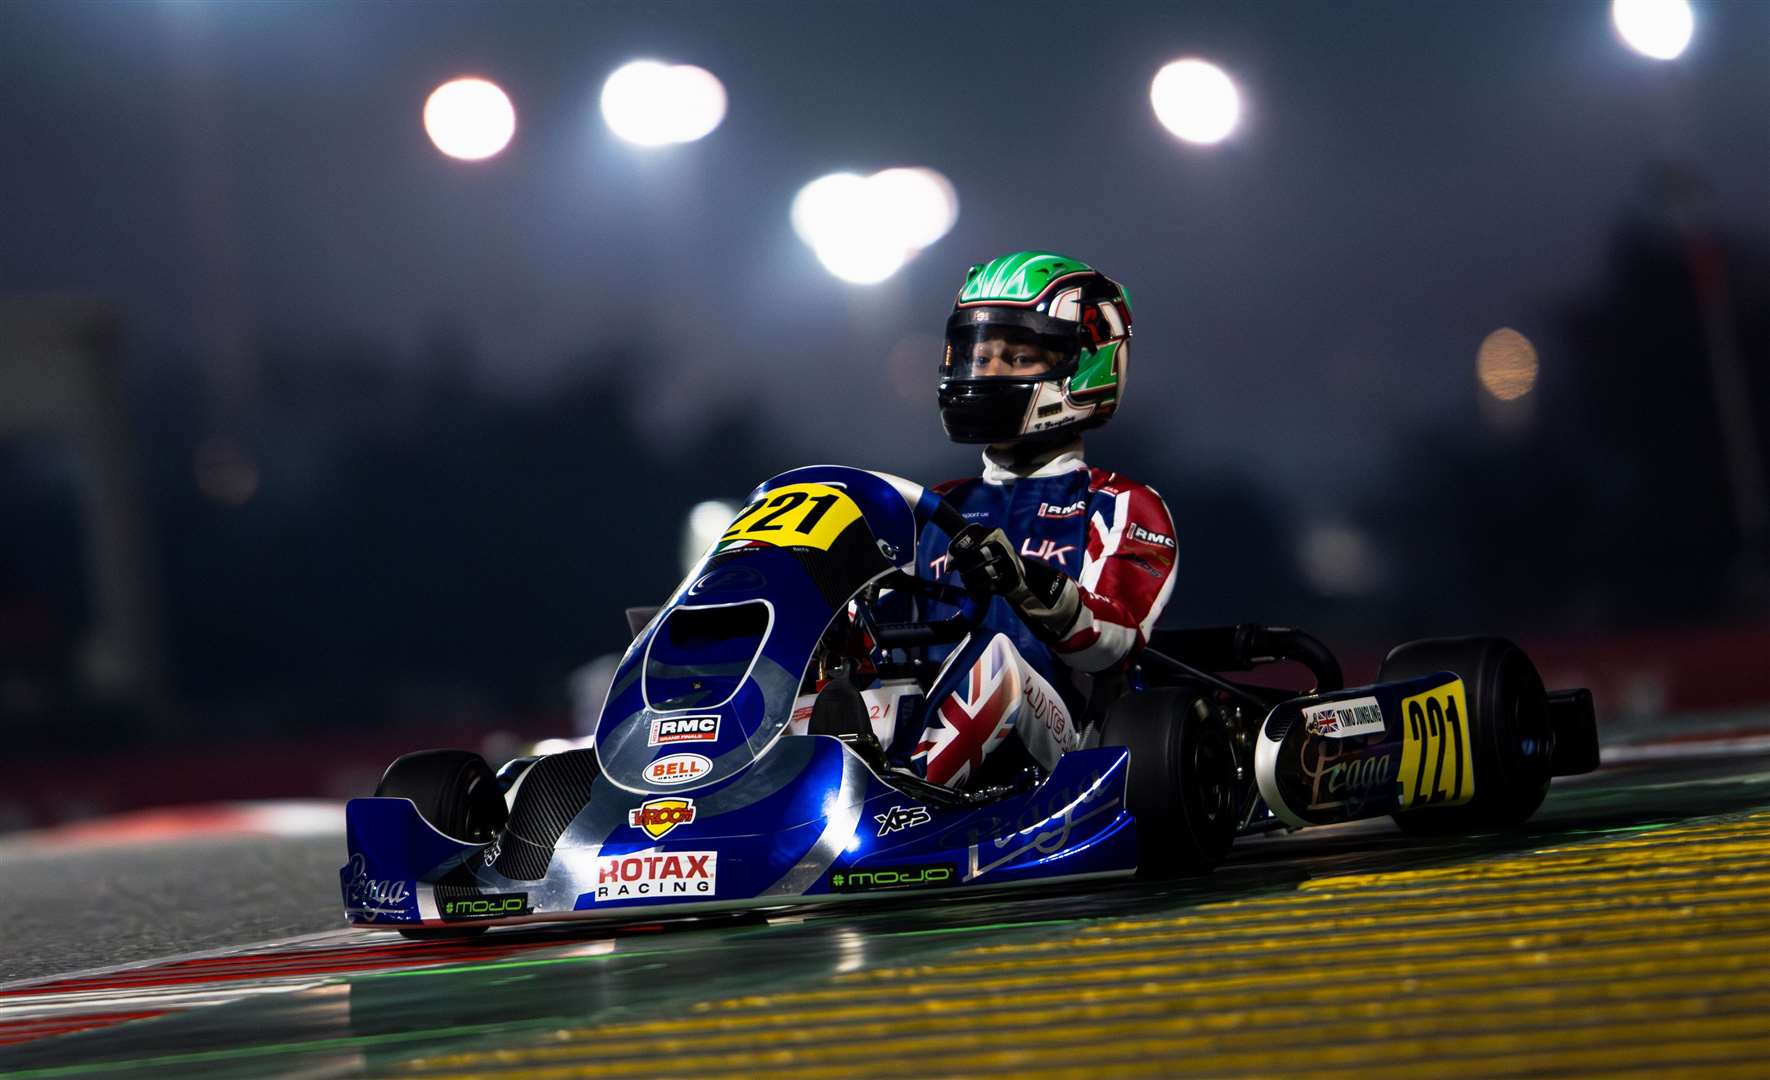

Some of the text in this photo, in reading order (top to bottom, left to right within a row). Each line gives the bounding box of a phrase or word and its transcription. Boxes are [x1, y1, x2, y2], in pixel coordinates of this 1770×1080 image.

[1047, 501, 1086, 514] RMC
[1135, 527, 1175, 548] RMC
[1020, 538, 1076, 566] UK
[661, 719, 715, 735] RMC
[1336, 708, 1356, 728] TIMO
[1408, 695, 1464, 805] 221
[653, 761, 700, 776] BELL
[874, 806, 931, 837] XPS
[599, 855, 710, 884] ROTAX
[598, 881, 709, 897] RACING
